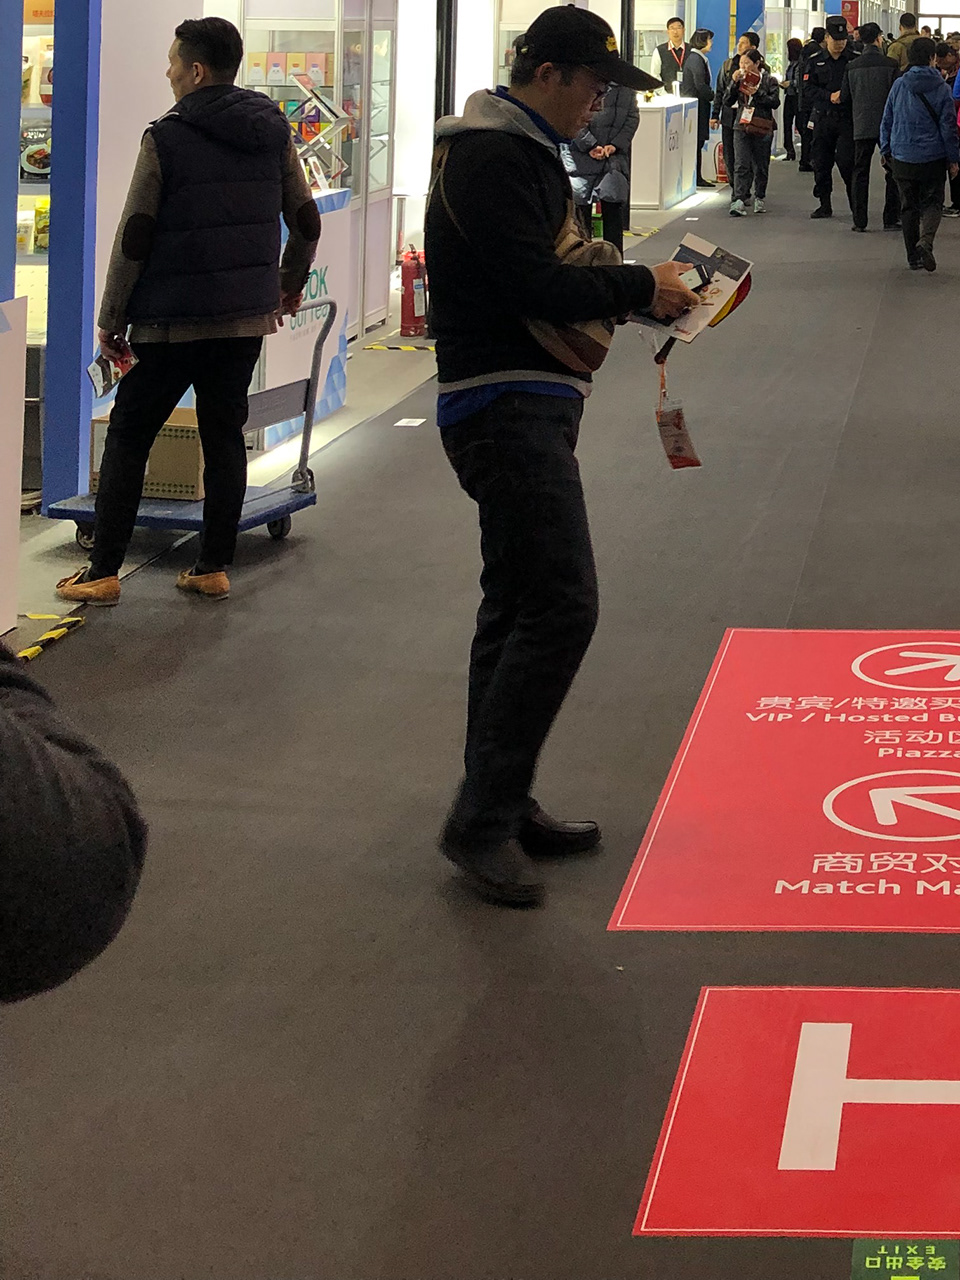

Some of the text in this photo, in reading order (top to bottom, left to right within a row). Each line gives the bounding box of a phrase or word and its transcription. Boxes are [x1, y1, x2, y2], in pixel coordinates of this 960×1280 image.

[746, 712, 793, 722] VIP
[802, 712, 816, 723] /
[824, 713, 929, 723] Hosted
[775, 879, 901, 895] Match
[877, 1245, 936, 1255] EXIT
[865, 1256, 946, 1271] 安全出口
